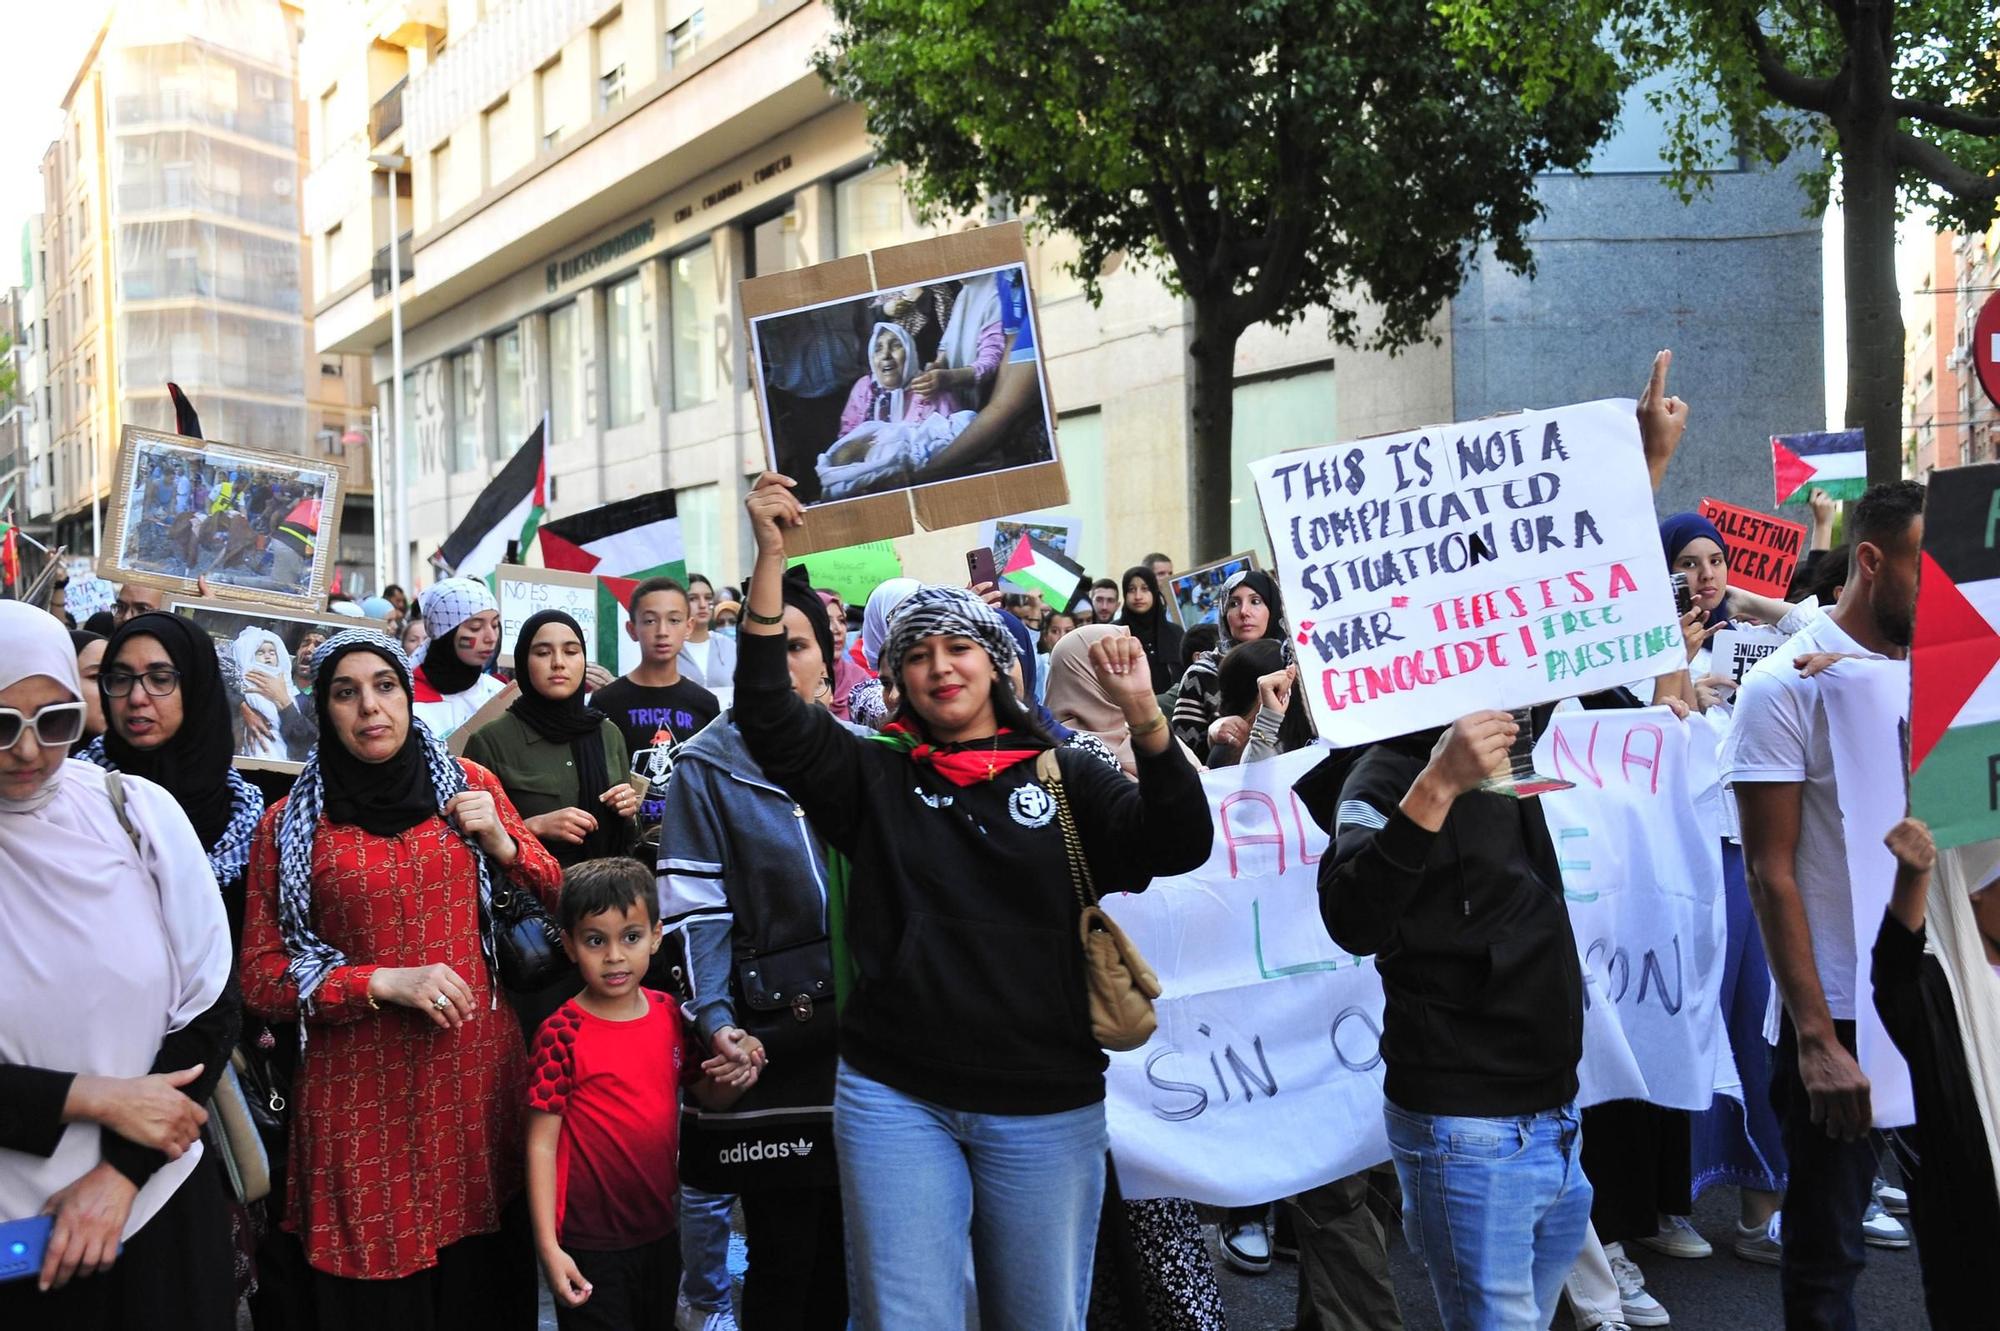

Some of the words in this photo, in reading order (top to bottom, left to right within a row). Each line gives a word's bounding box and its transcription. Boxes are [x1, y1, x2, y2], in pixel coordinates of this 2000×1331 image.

[1271, 448, 1366, 503] THIS
[1385, 436, 1433, 493] IS
[1456, 426, 1530, 480] NOT
[1541, 421, 1571, 462] A
[1290, 472, 1561, 560] COMPLICATED
[1301, 522, 1498, 610] SITUATION
[1510, 515, 1565, 553] OR
[1574, 509, 1604, 548] A
[1726, 545, 1793, 587] NCERÁ!
[504, 581, 527, 600] NO
[530, 583, 549, 602] ES
[1536, 571, 1594, 610] IS
[1609, 563, 1638, 599] A
[1534, 604, 1622, 641] FREE
[1545, 624, 1682, 683] PALESTINE
[1733, 643, 1778, 658] LESTINE
[628, 708, 672, 727] TRICK
[676, 711, 694, 729] OR
[719, 1141, 790, 1163] adidas
